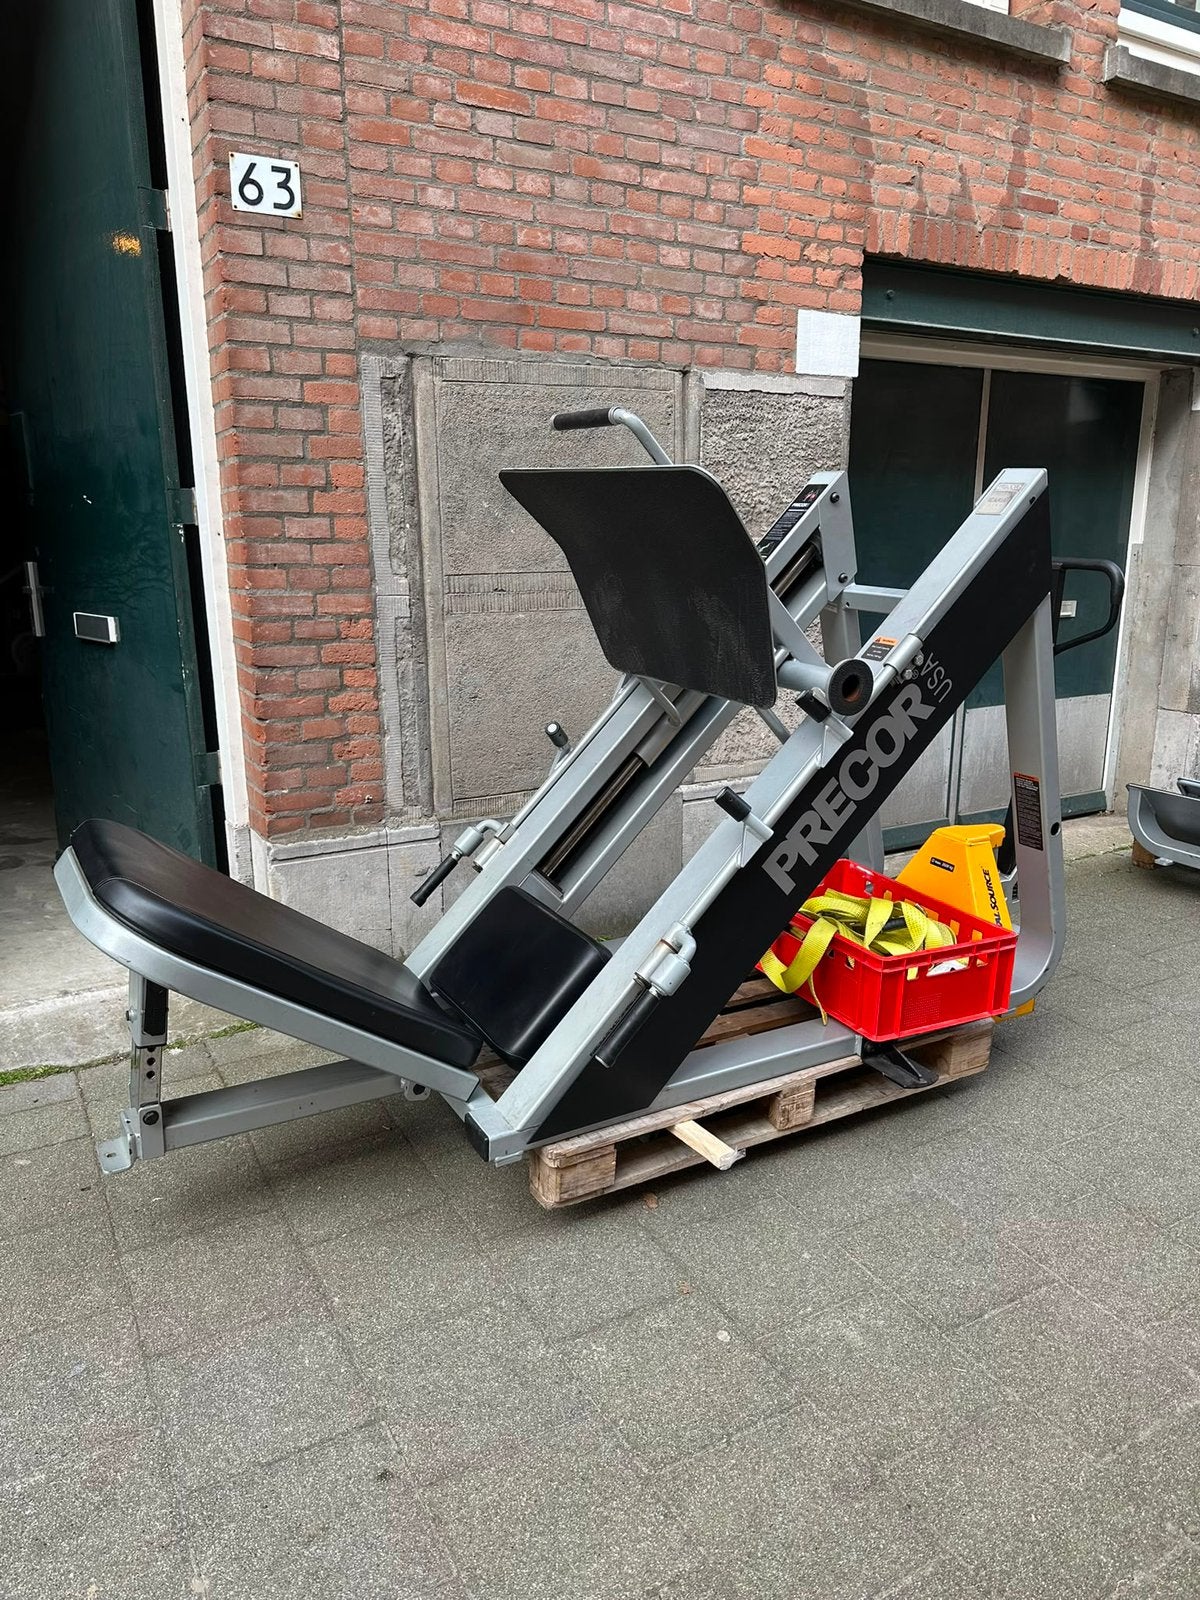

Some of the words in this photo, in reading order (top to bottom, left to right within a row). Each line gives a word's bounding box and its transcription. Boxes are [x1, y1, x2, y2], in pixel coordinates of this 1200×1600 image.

[238, 162, 296, 210] 63
[920, 652, 953, 703] USA
[761, 683, 936, 896] PRECOR
